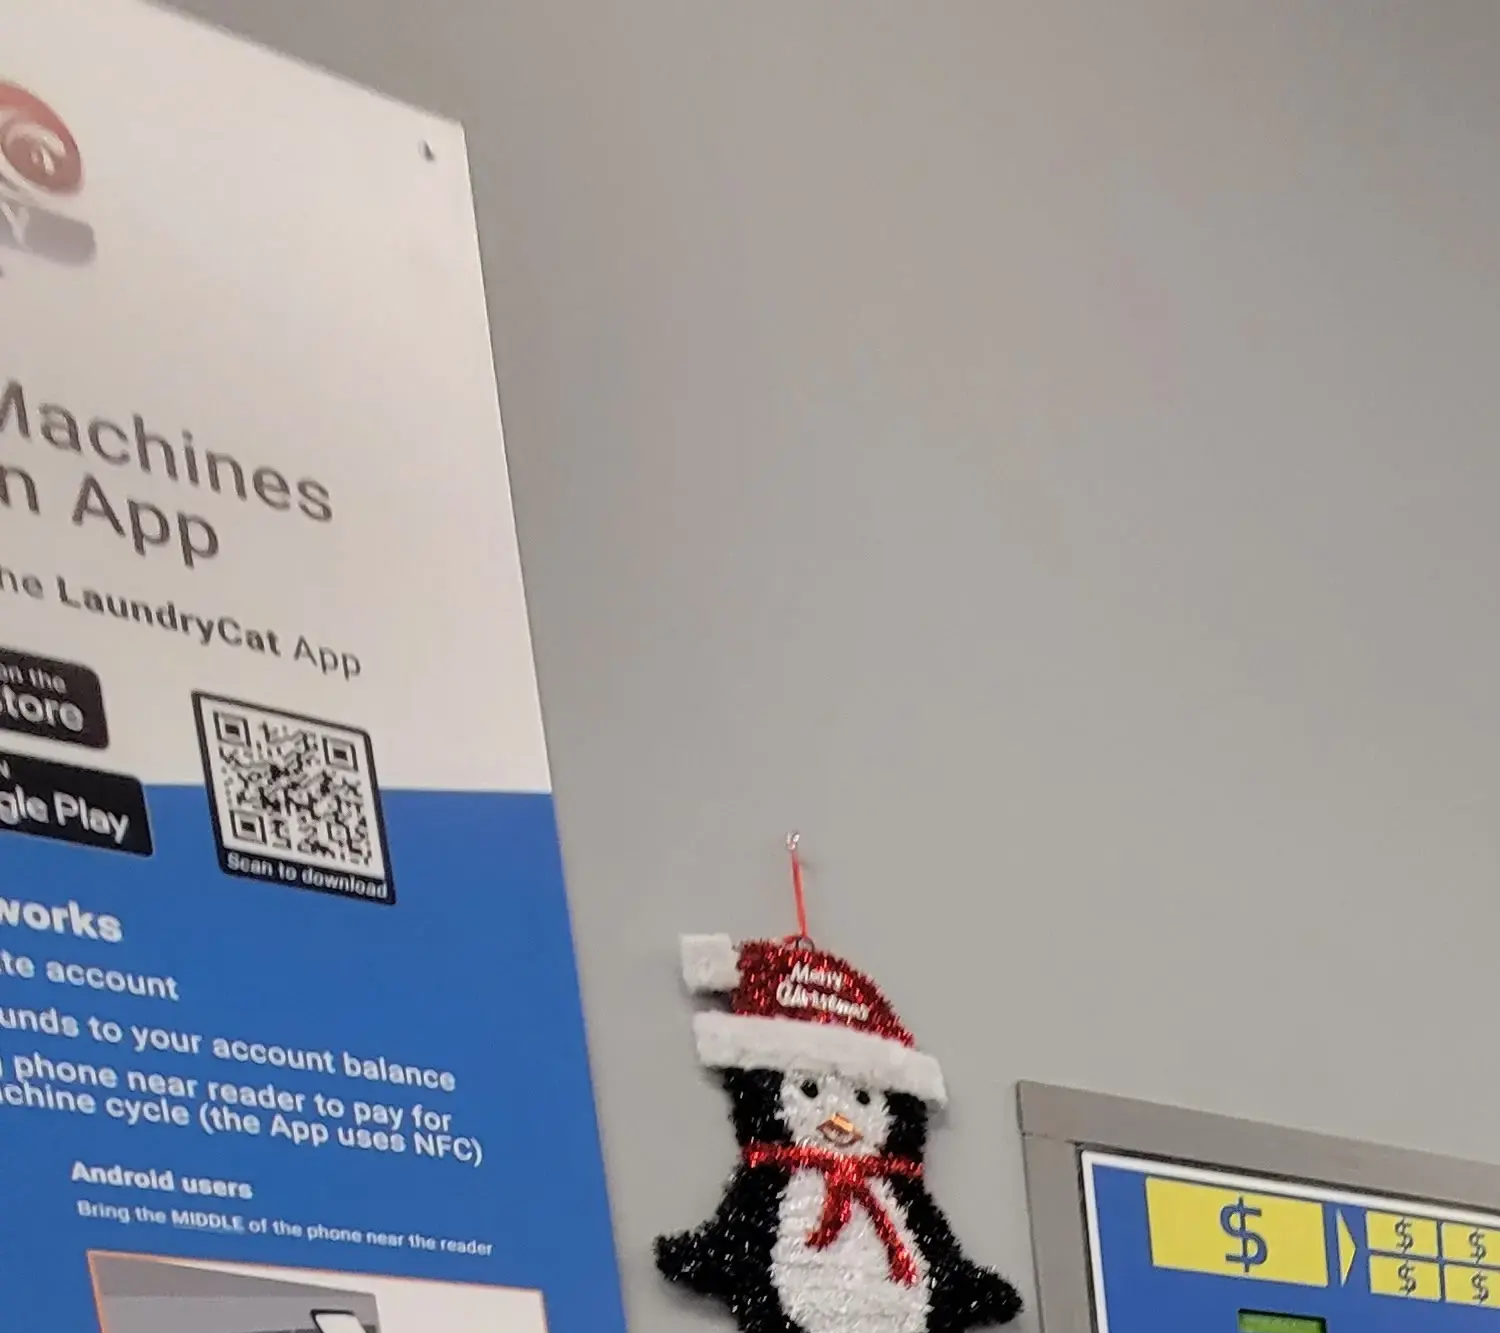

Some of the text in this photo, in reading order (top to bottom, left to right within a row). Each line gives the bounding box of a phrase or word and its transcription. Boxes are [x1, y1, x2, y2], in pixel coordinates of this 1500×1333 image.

[71, 472, 219, 569] App
[56, 574, 362, 681] LaundryCat App
[28, 667, 67, 694] the
[53, 791, 129, 845] Play
[227, 852, 388, 899] Scan to download
[46, 960, 179, 1001] account
[790, 961, 842, 992] Merry
[88, 1015, 122, 1043] to
[131, 1024, 202, 1054] your
[213, 1037, 336, 1075] account
[343, 1051, 456, 1092] balance
[13, 1052, 452, 1133] phone near reader to pay for
[105, 1096, 189, 1126] cycle
[200, 1101, 260, 1135] (the
[270, 1113, 328, 1147] App
[337, 1126, 406, 1152] uses
[414, 1131, 483, 1168] NFC)
[71, 1160, 253, 1199] Android users
[77, 1200, 492, 1256] Bring the MIDDLE of the phone near the reader
